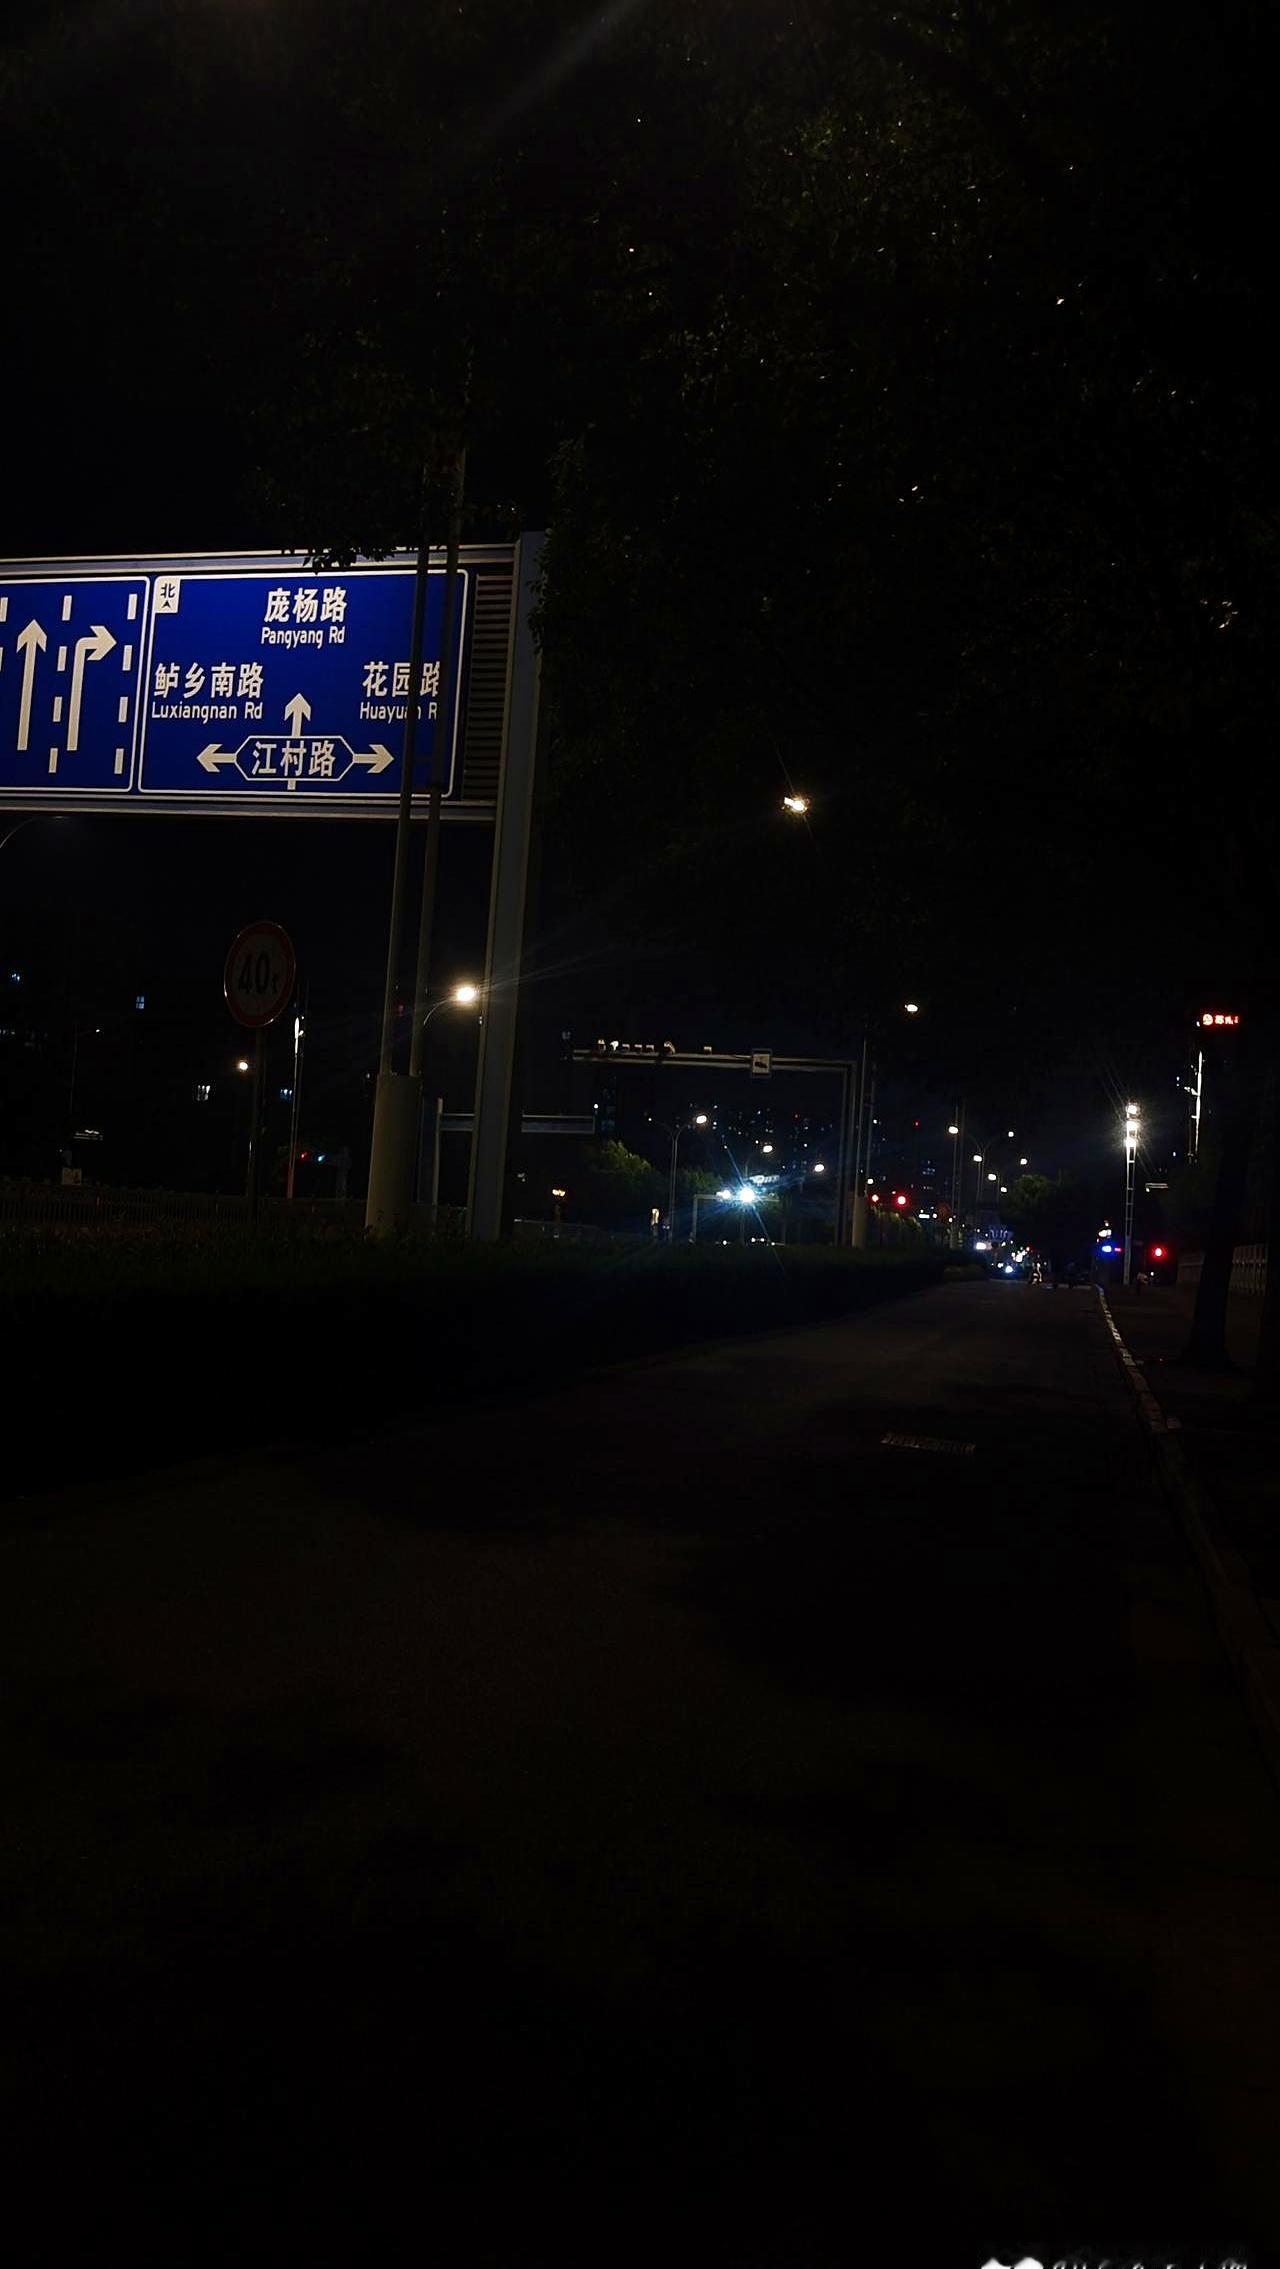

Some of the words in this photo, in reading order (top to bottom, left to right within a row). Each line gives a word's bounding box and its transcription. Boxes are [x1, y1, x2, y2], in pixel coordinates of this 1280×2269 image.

[160, 583, 175, 598] 北
[264, 587, 347, 623] 庞杨路
[261, 626, 323, 649] Pangyang
[328, 626, 345, 644] Rd
[154, 662, 264, 698] 鲈乡南路
[151, 701, 237, 724] Luxiangnan
[243, 701, 263, 719] Rd
[251, 741, 336, 777] 江村路
